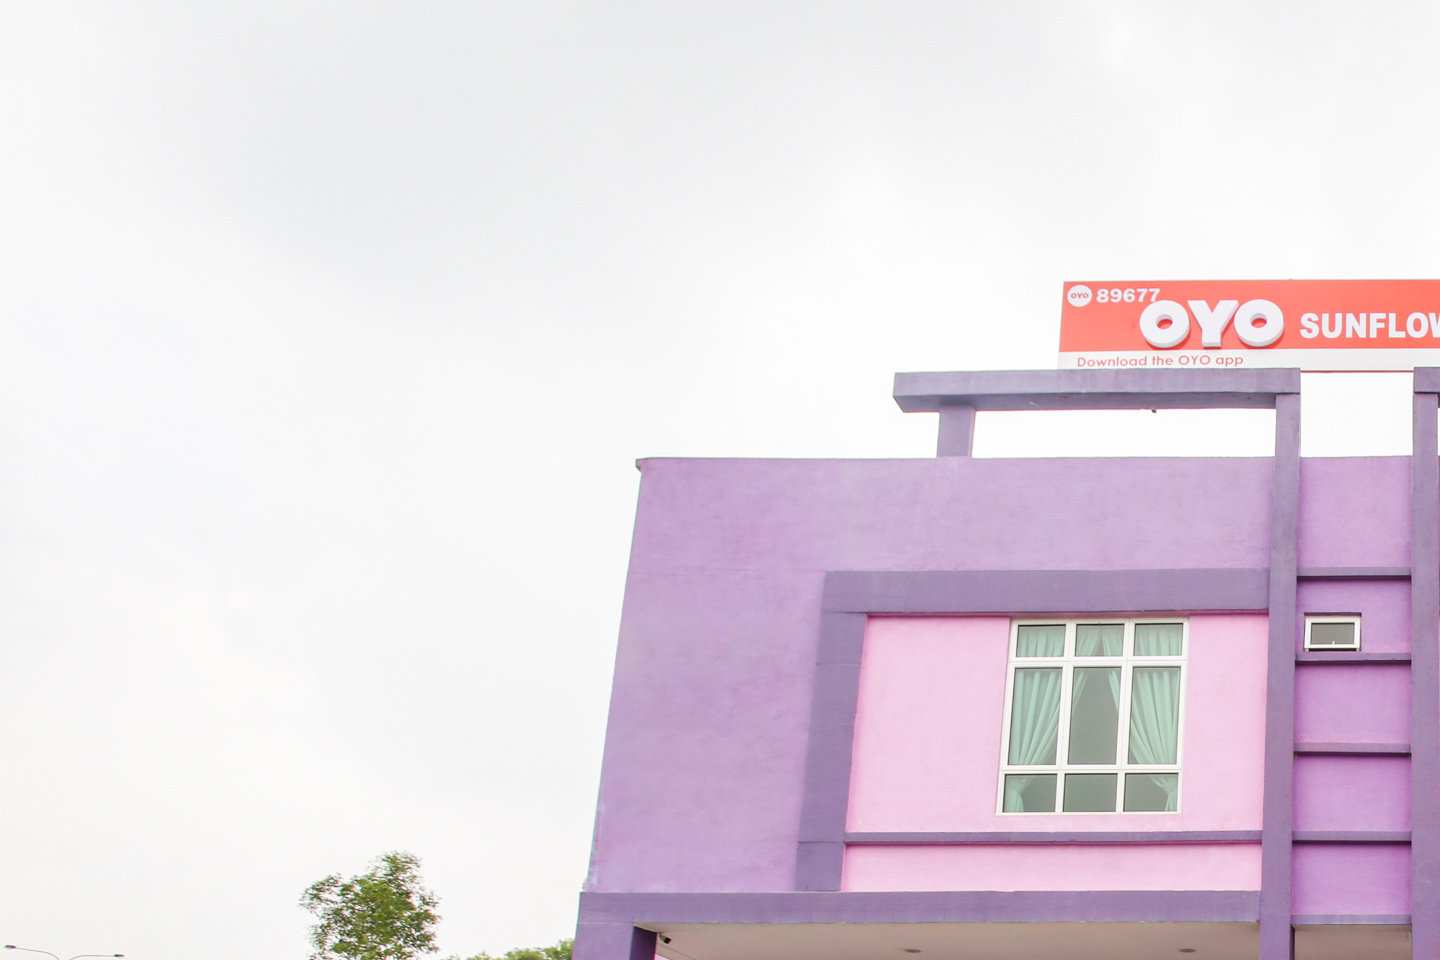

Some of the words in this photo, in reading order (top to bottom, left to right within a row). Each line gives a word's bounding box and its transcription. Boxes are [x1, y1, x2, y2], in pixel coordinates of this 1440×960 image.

[1096, 288, 1161, 303] 89677
[1139, 299, 1285, 348] OYO
[1077, 356, 1148, 367] Download
[1152, 356, 1174, 366] the
[1178, 355, 1211, 366] OYO
[1215, 356, 1244, 367] app
